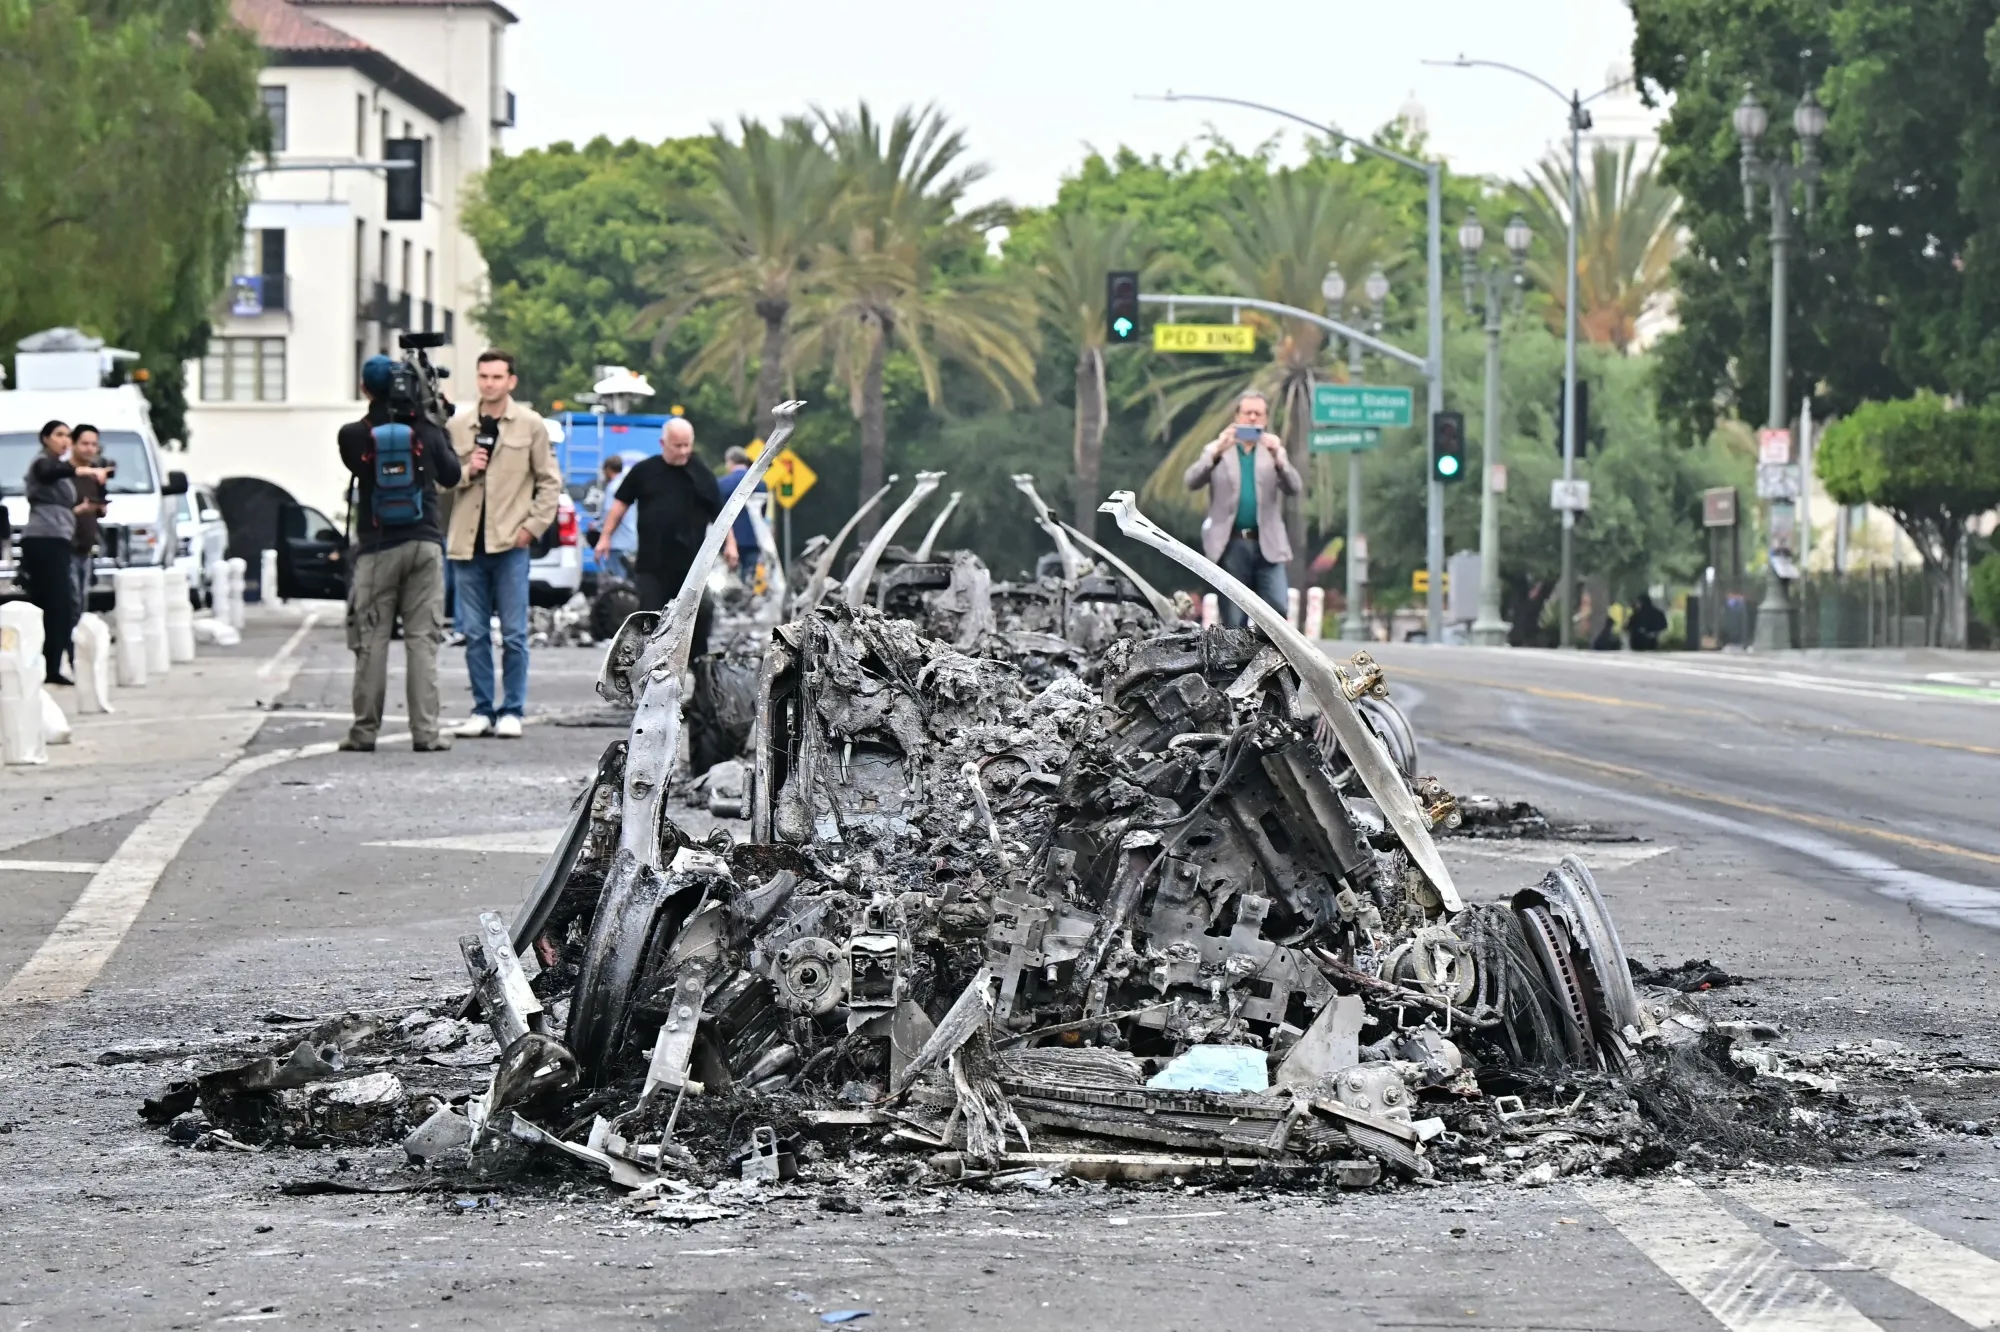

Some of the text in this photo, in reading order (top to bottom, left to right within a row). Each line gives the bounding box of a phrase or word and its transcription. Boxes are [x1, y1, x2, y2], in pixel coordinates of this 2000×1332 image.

[1162, 329, 1246, 346] PED XING
[1318, 391, 1407, 408] Union Station
